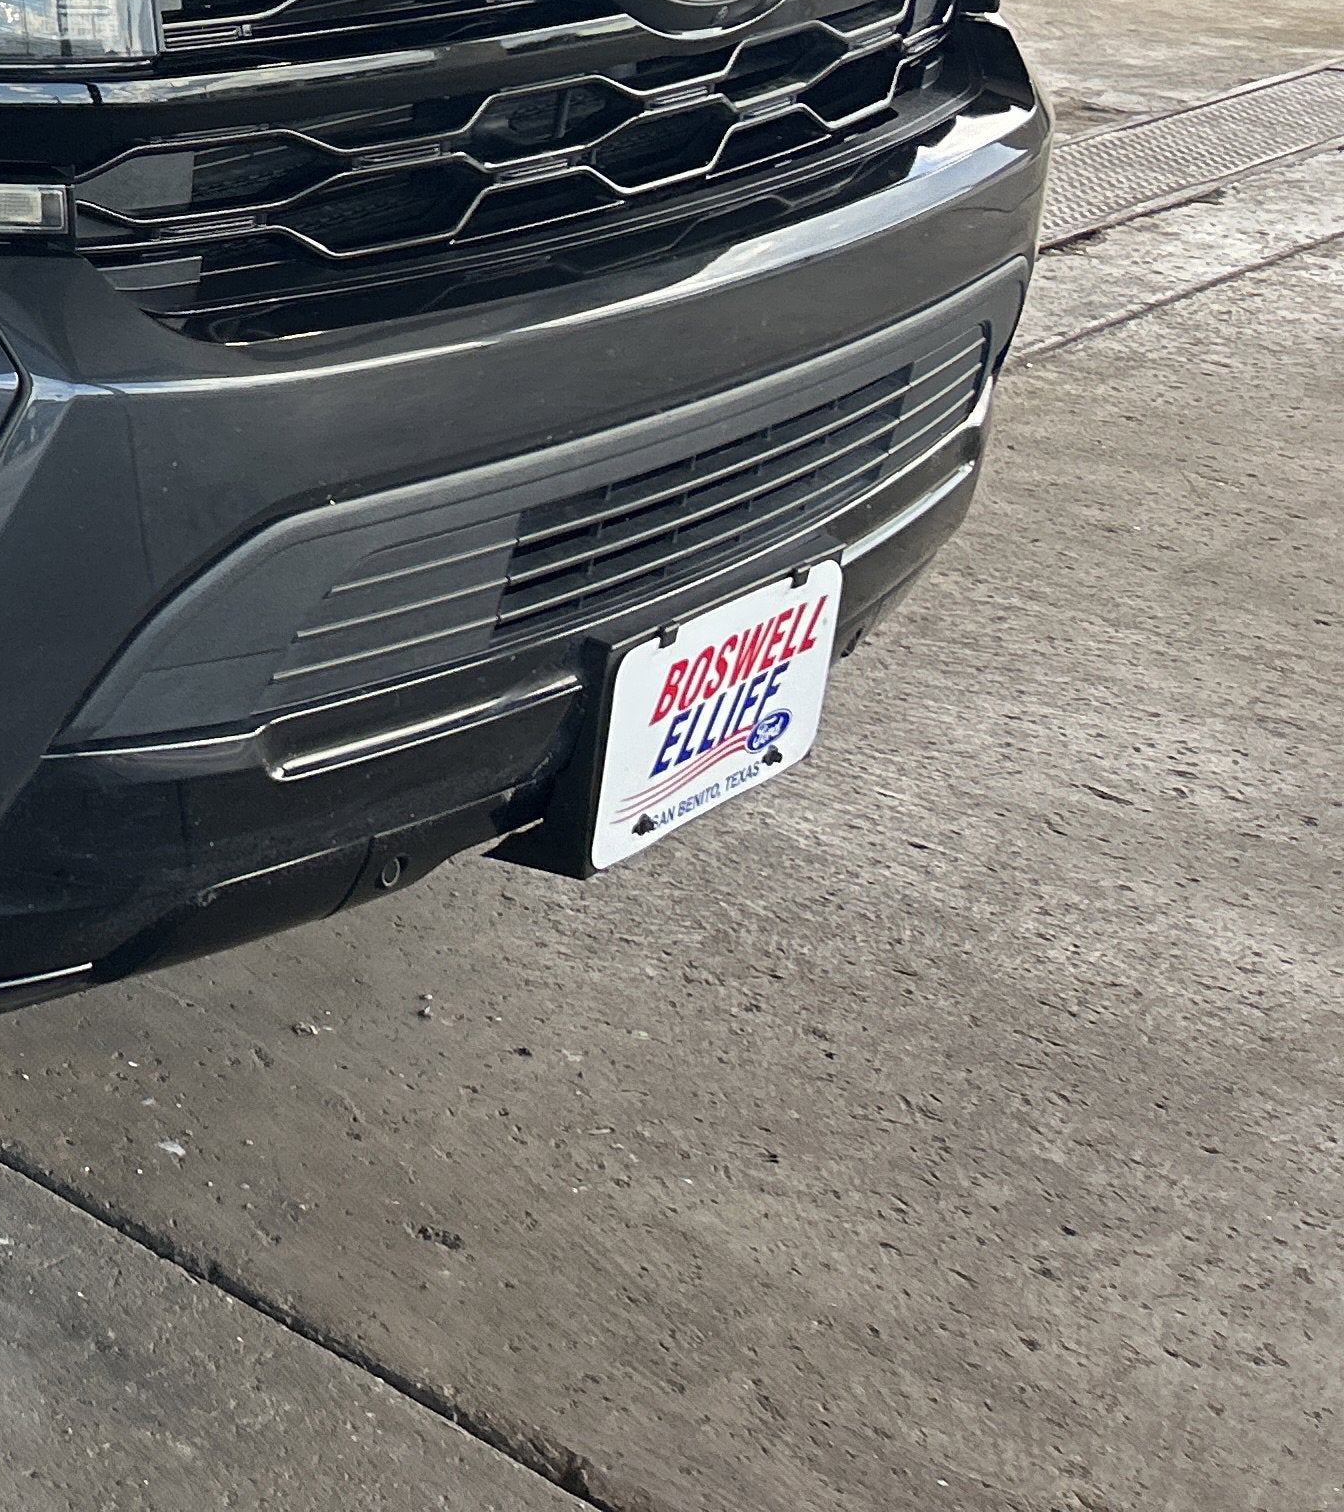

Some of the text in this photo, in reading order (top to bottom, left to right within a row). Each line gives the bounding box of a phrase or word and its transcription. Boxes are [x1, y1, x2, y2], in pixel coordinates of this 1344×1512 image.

[648, 594, 829, 727] BOSWELL
[649, 661, 790, 780] ELLIFF
[653, 760, 761, 829] SAN BENITO, TEXAS
